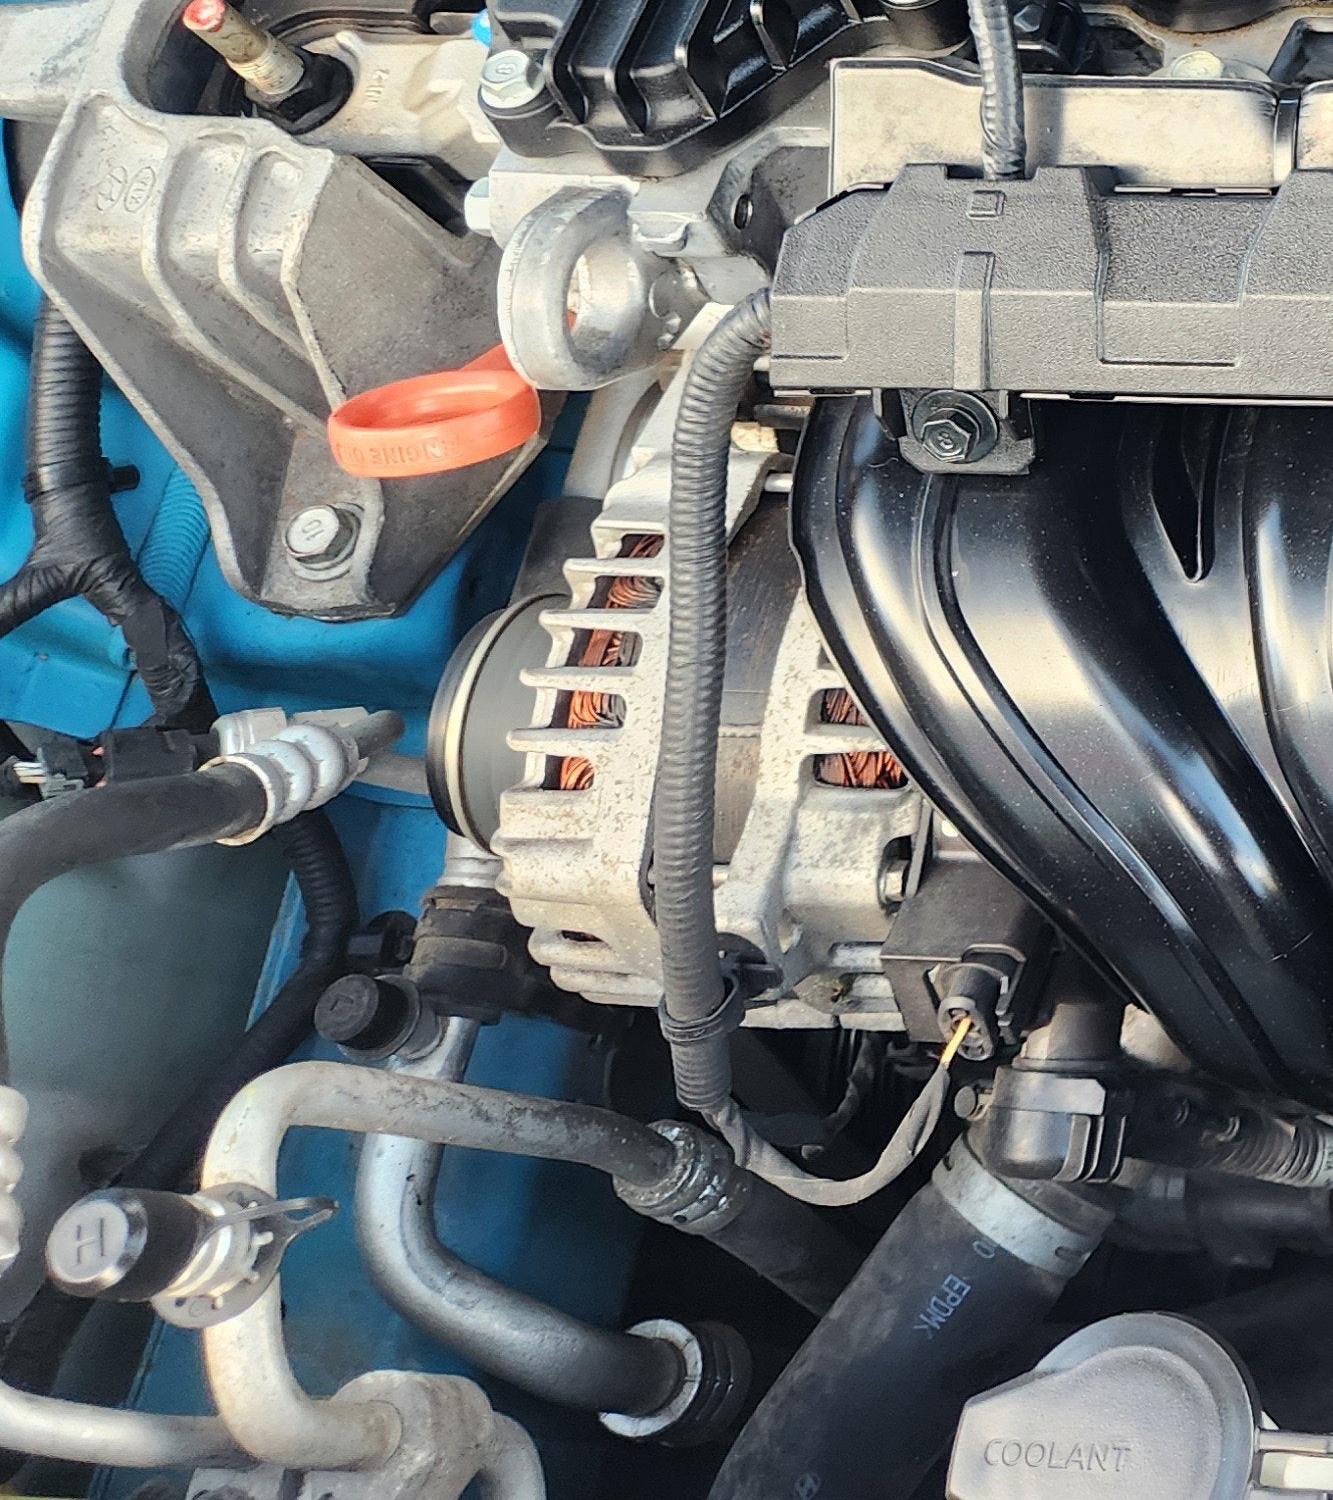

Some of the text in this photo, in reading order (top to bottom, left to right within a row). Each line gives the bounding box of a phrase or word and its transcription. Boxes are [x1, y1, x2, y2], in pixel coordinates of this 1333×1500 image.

[372, 432, 461, 465] ENGINE
[75, 1216, 106, 1265] H
[983, 1437, 1132, 1473] COOLANT
